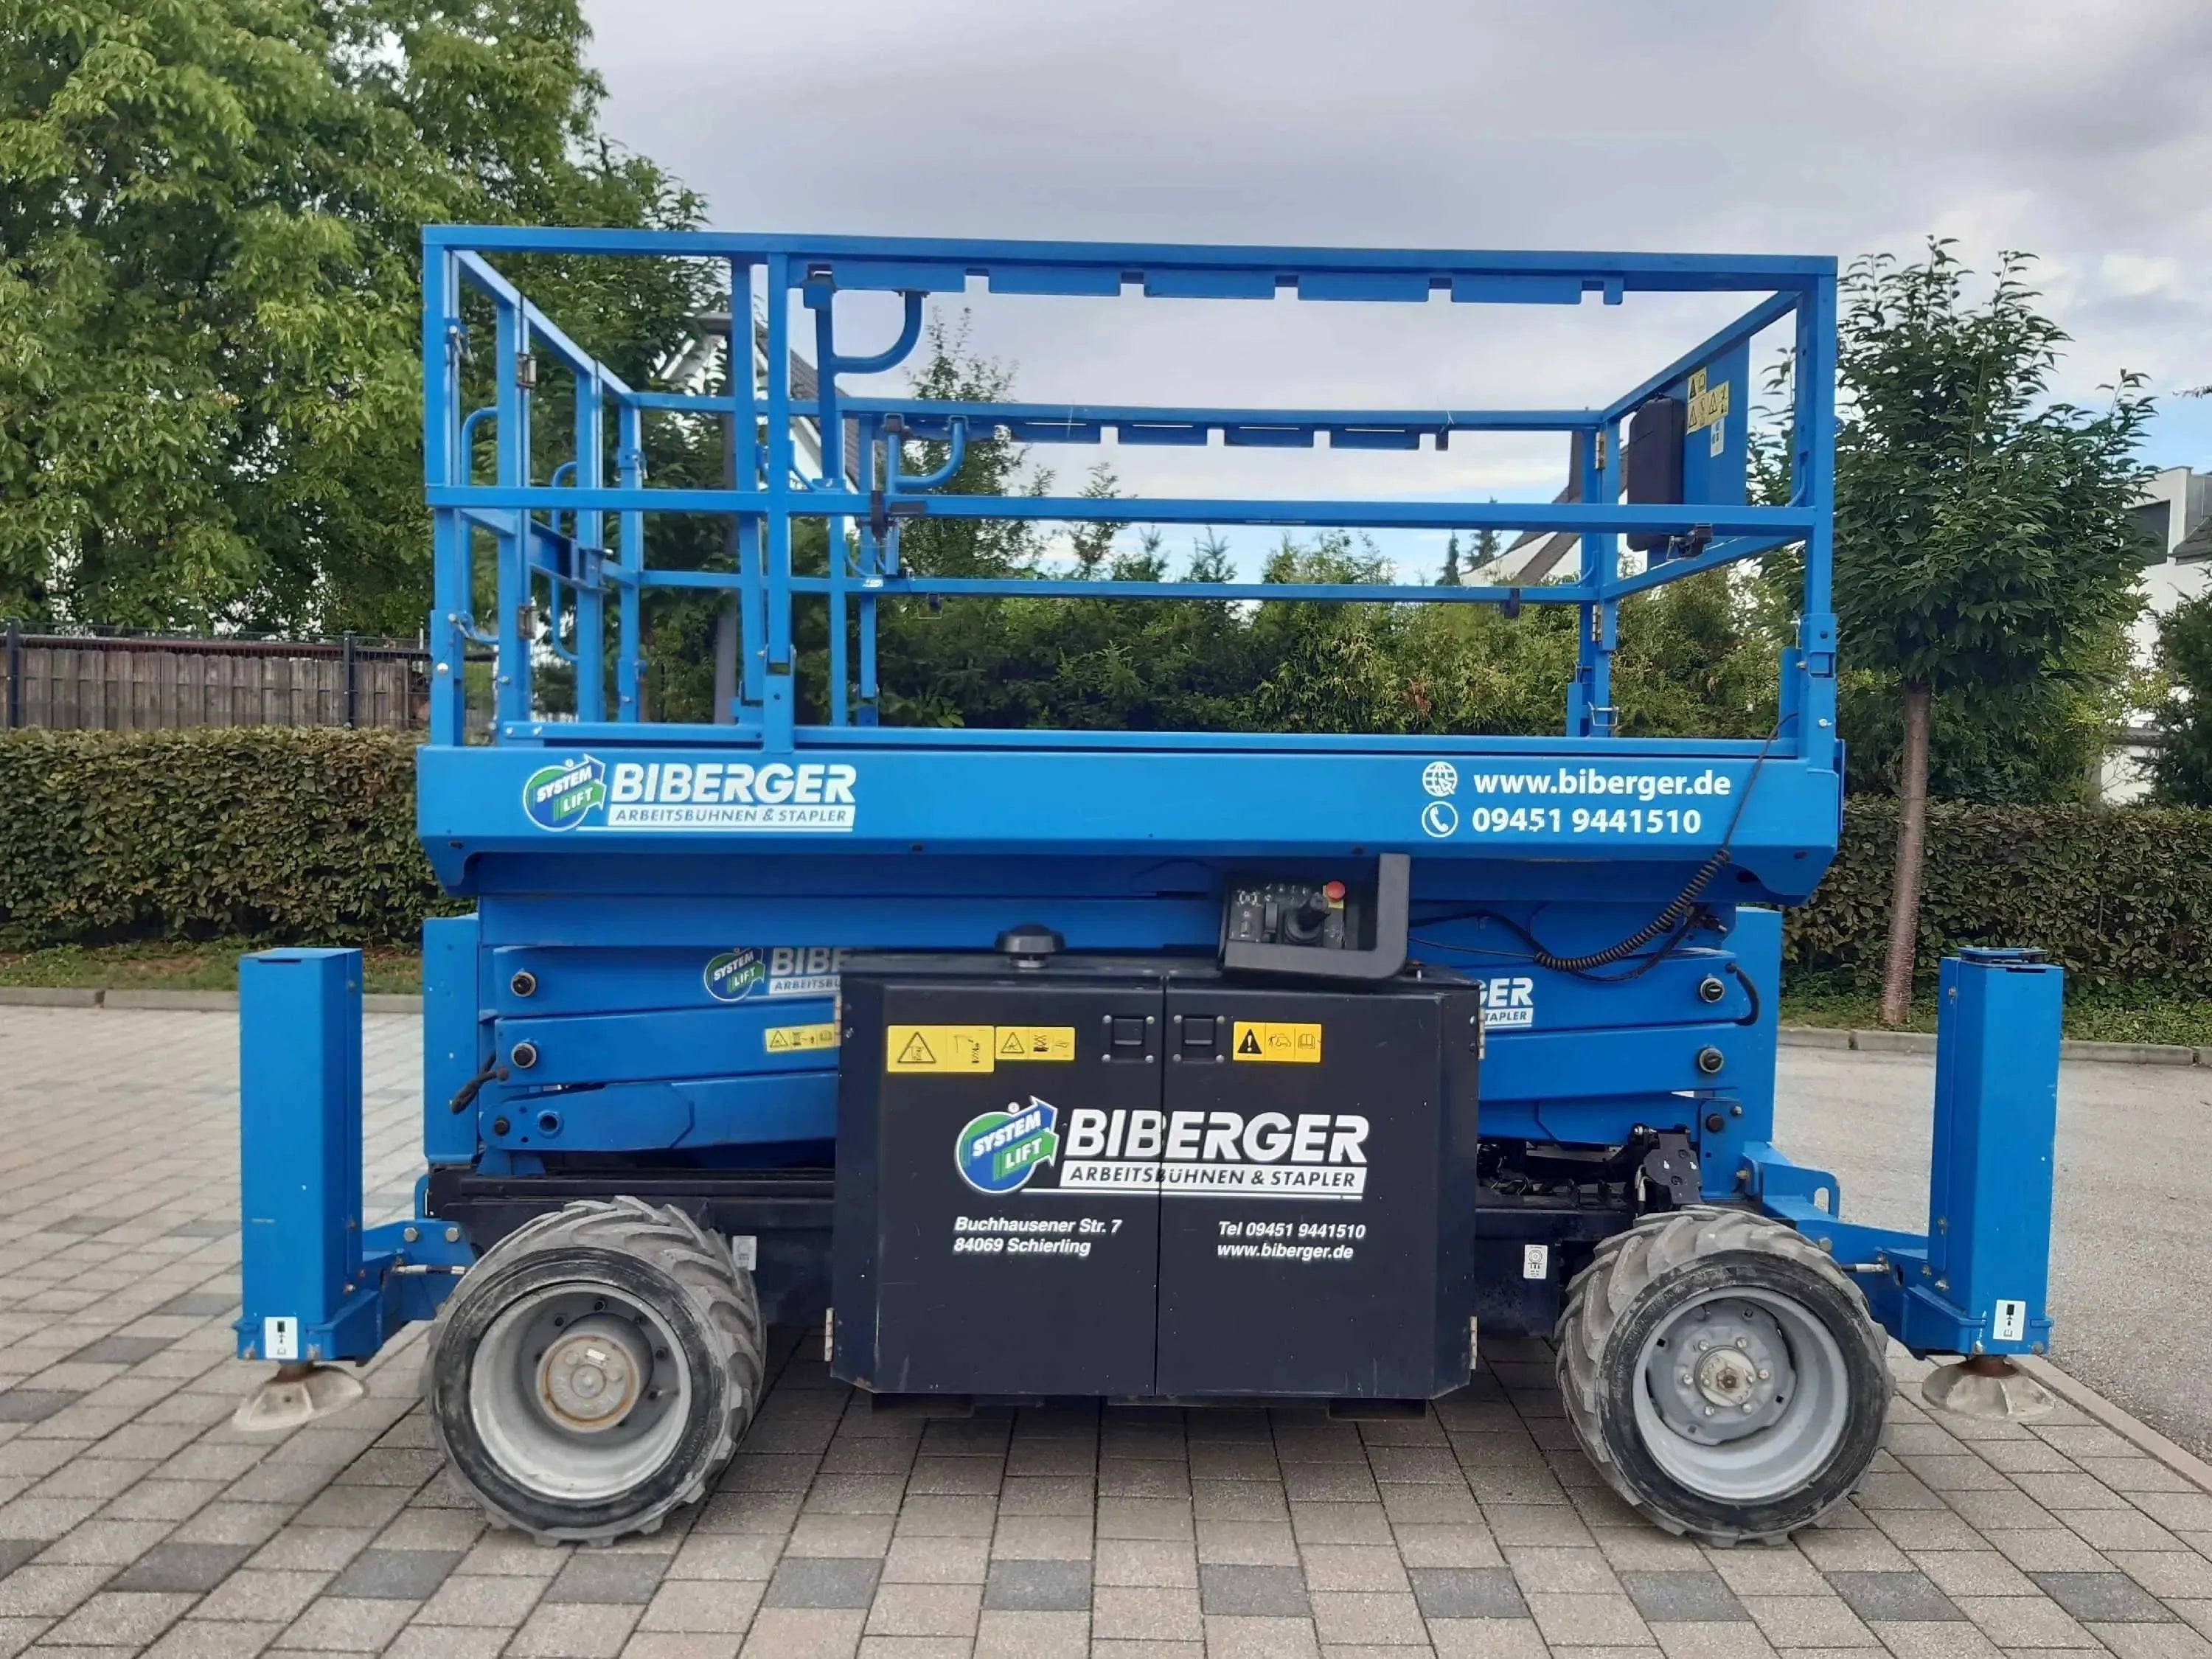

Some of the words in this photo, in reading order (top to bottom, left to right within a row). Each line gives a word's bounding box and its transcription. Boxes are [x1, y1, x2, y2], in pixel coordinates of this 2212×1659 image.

[537, 765, 592, 802] SYSTEM
[611, 762, 857, 803] BIBERGER
[1474, 768, 1731, 801] www.biberger.de
[563, 787, 593, 812] LIFT
[762, 808, 773, 822] &
[778, 810, 846, 822] STAPLER
[1472, 807, 1561, 832] 09451
[1572, 807, 1702, 833] 9441510
[714, 950, 754, 981] SYSTEM
[734, 967, 756, 987] LIFT
[973, 1110, 1041, 1157] SYSTEM
[1065, 1108, 1369, 1164] BIBERGER
[1005, 1138, 1043, 1169] LIFT
[1070, 1166, 1245, 1186] ARBEITSBÜHNEN
[1251, 1169, 1265, 1185] &
[1270, 1171, 1355, 1187] STAPLER
[954, 1216, 1076, 1232] Buchhausener
[1079, 1218, 1106, 1233] Str.
[1110, 1219, 1123, 1234] 7
[1218, 1221, 1243, 1236] Tel
[1245, 1222, 1293, 1237] 09451
[1298, 1223, 1366, 1239] 9441510
[953, 1237, 1004, 1252] 84069
[1007, 1237, 1091, 1257] Schierling
[1217, 1242, 1354, 1262] www.biberger.de
